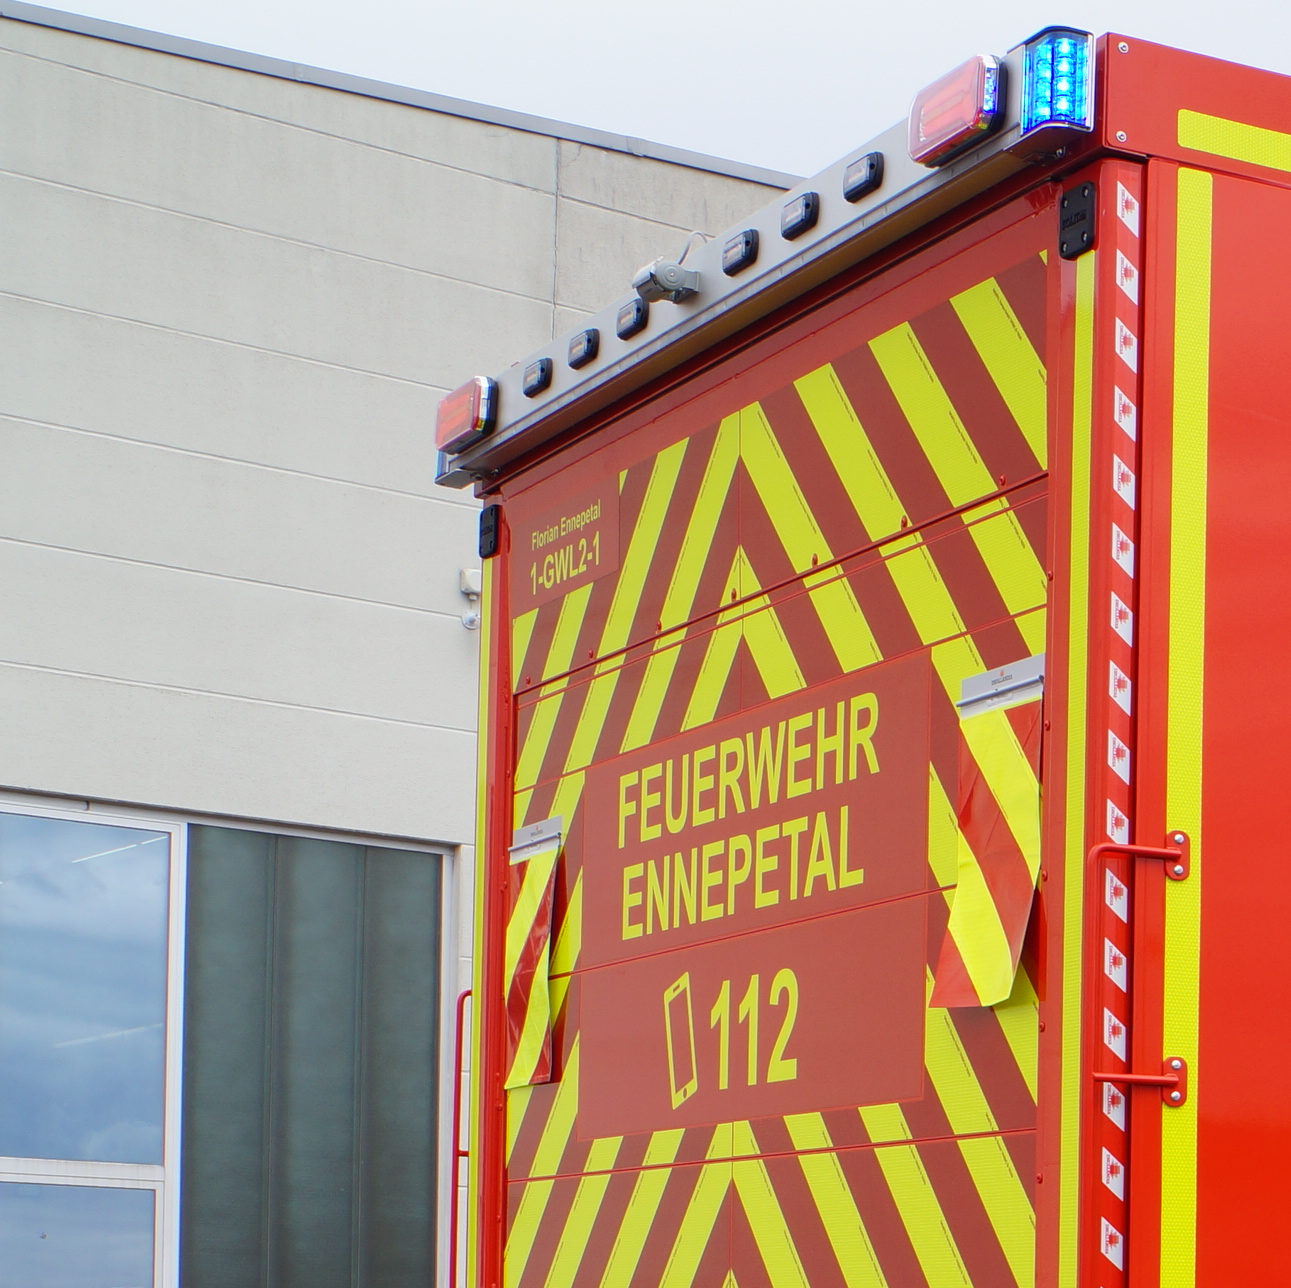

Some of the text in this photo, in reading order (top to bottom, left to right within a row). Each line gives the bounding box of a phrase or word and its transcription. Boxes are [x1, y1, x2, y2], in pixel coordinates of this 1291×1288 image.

[530, 530, 600, 595] 1-GWL2-1
[531, 499, 601, 551] Florian Ennepetal
[617, 692, 881, 849] FEUERWEHR
[621, 805, 865, 941] ENNEPETAL
[710, 967, 800, 1091] 112
